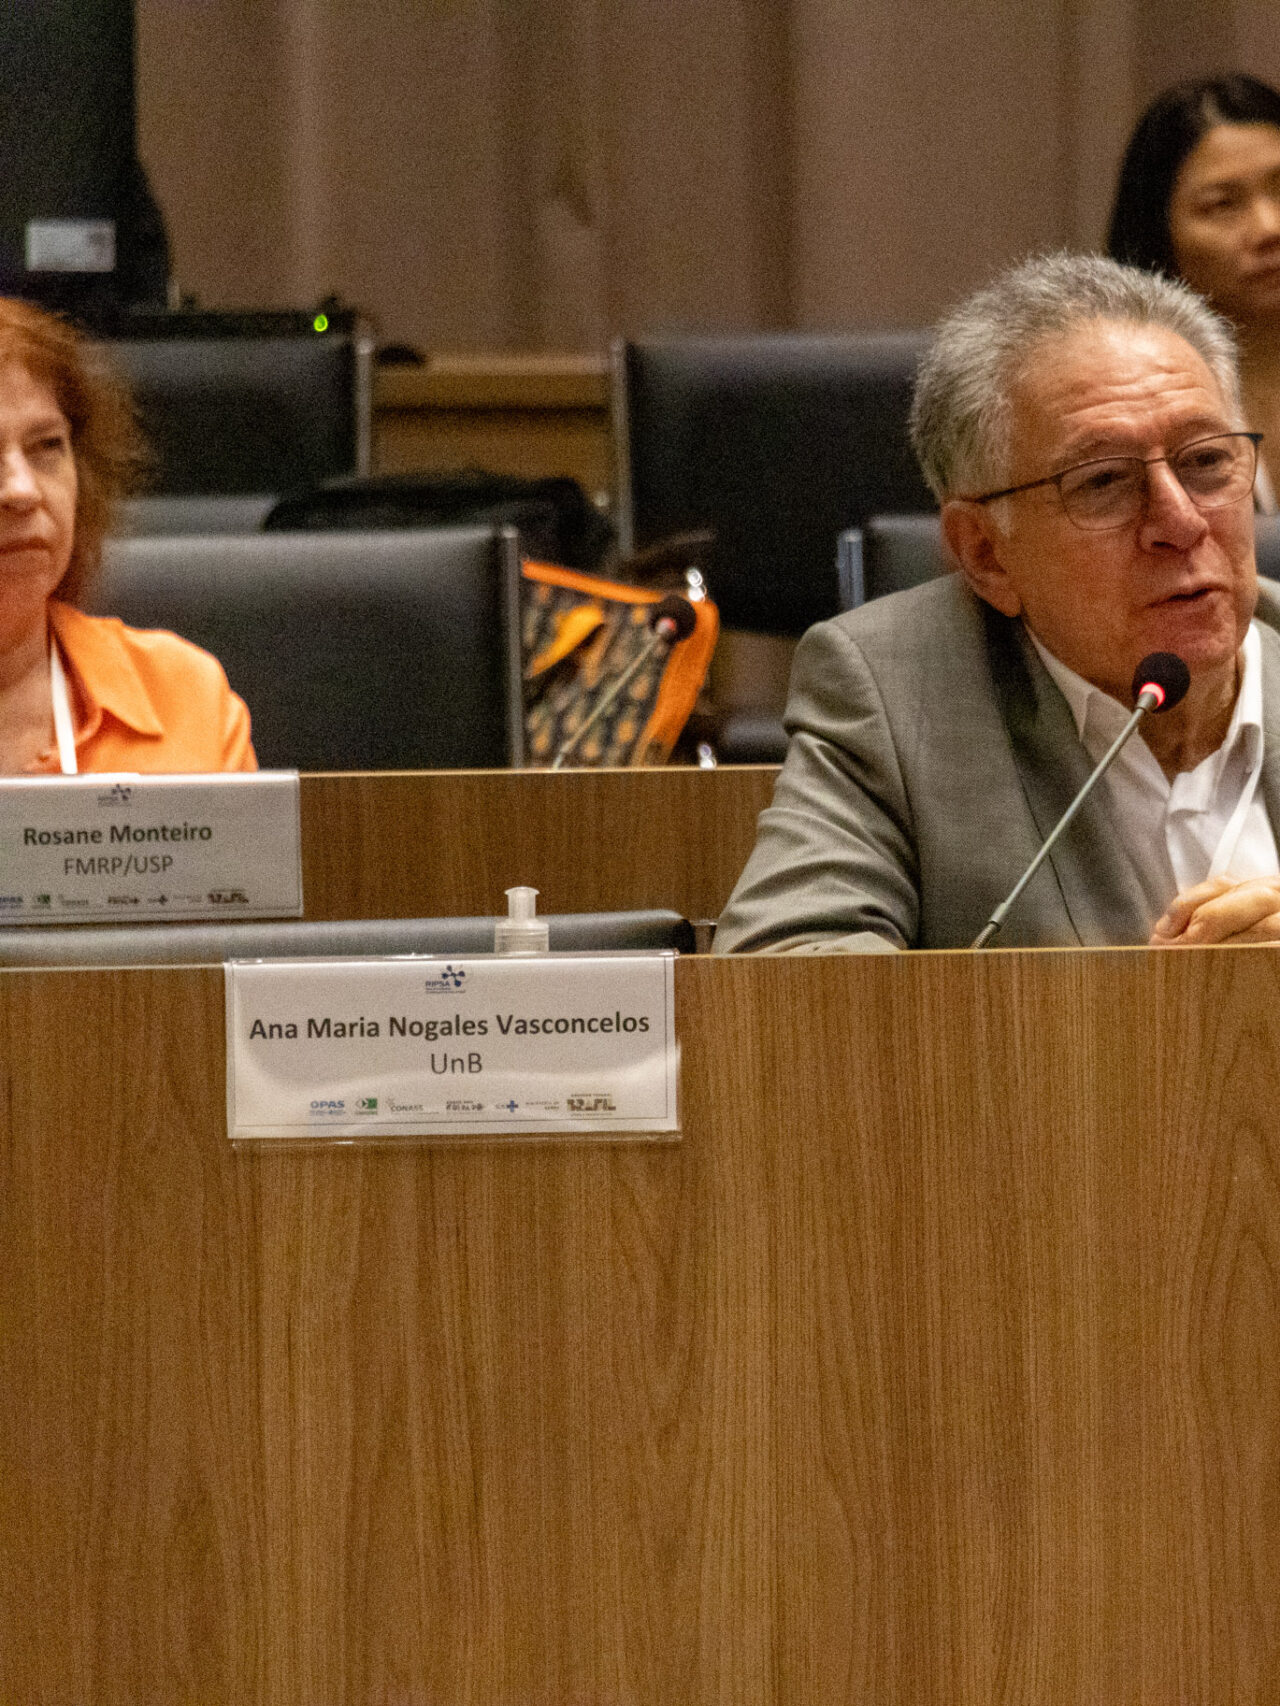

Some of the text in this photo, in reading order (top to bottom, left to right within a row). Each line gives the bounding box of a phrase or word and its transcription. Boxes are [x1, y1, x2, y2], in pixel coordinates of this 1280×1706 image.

[23, 822, 213, 846] Rosane Monteiro
[63, 855, 174, 876] FMRP/USP
[249, 1010, 650, 1043] Ana Maria Nogales Vasconcelos
[430, 1051, 483, 1075] UnB
[309, 1100, 346, 1109] OPAS
